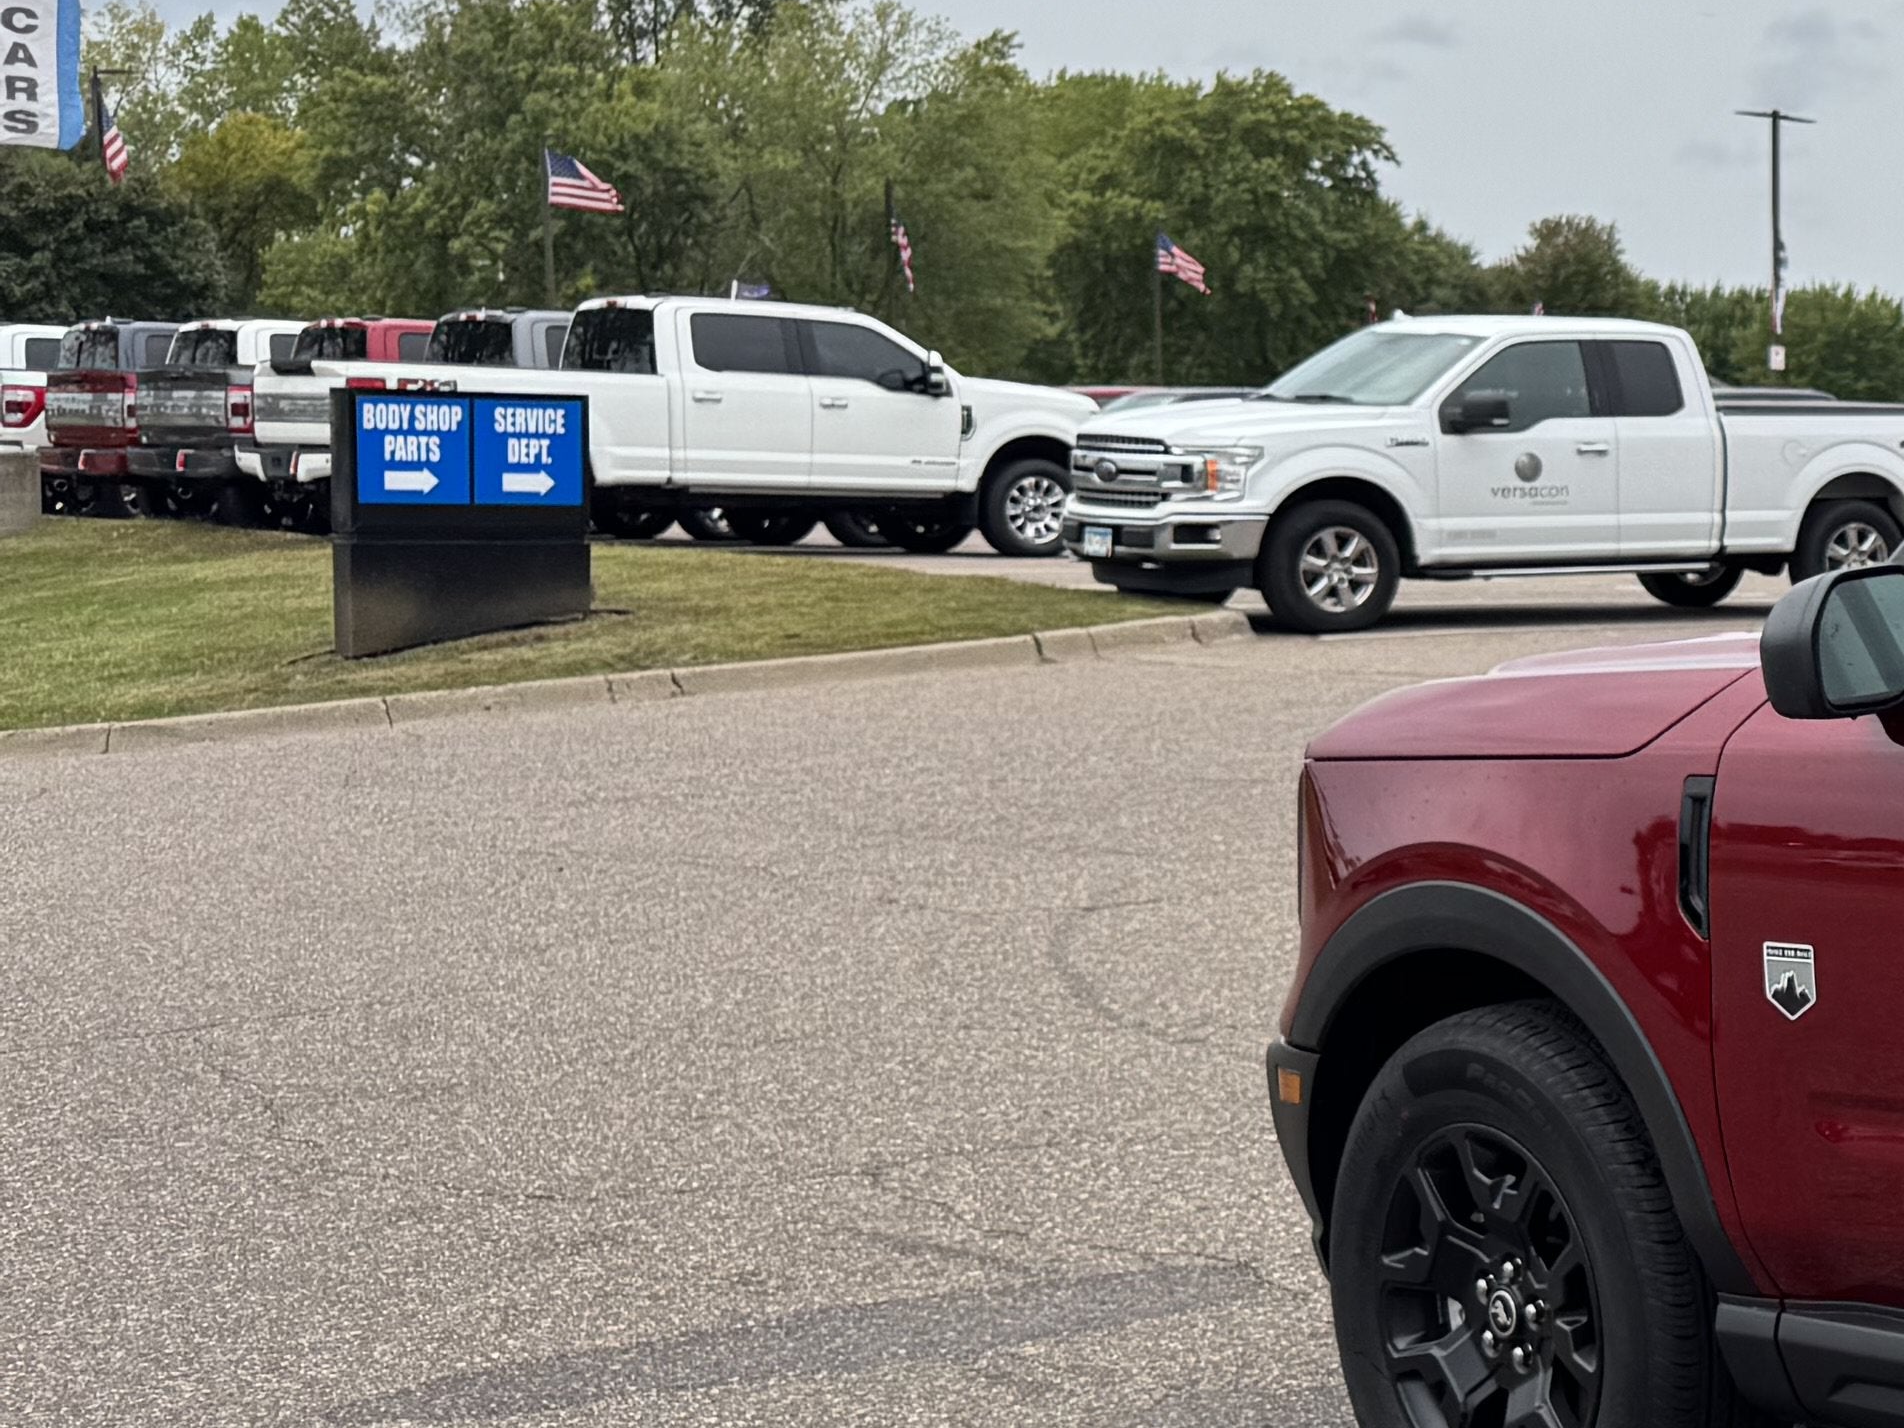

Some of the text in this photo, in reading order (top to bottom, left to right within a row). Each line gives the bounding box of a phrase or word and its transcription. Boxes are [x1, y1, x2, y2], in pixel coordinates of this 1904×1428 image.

[1, 6, 40, 135] CARS
[362, 402, 462, 432] BODY SHOP
[493, 406, 566, 435] SERVICE
[384, 434, 441, 462] PARTS
[507, 438, 552, 465] DEPT.
[1490, 483, 1570, 500] versacon
